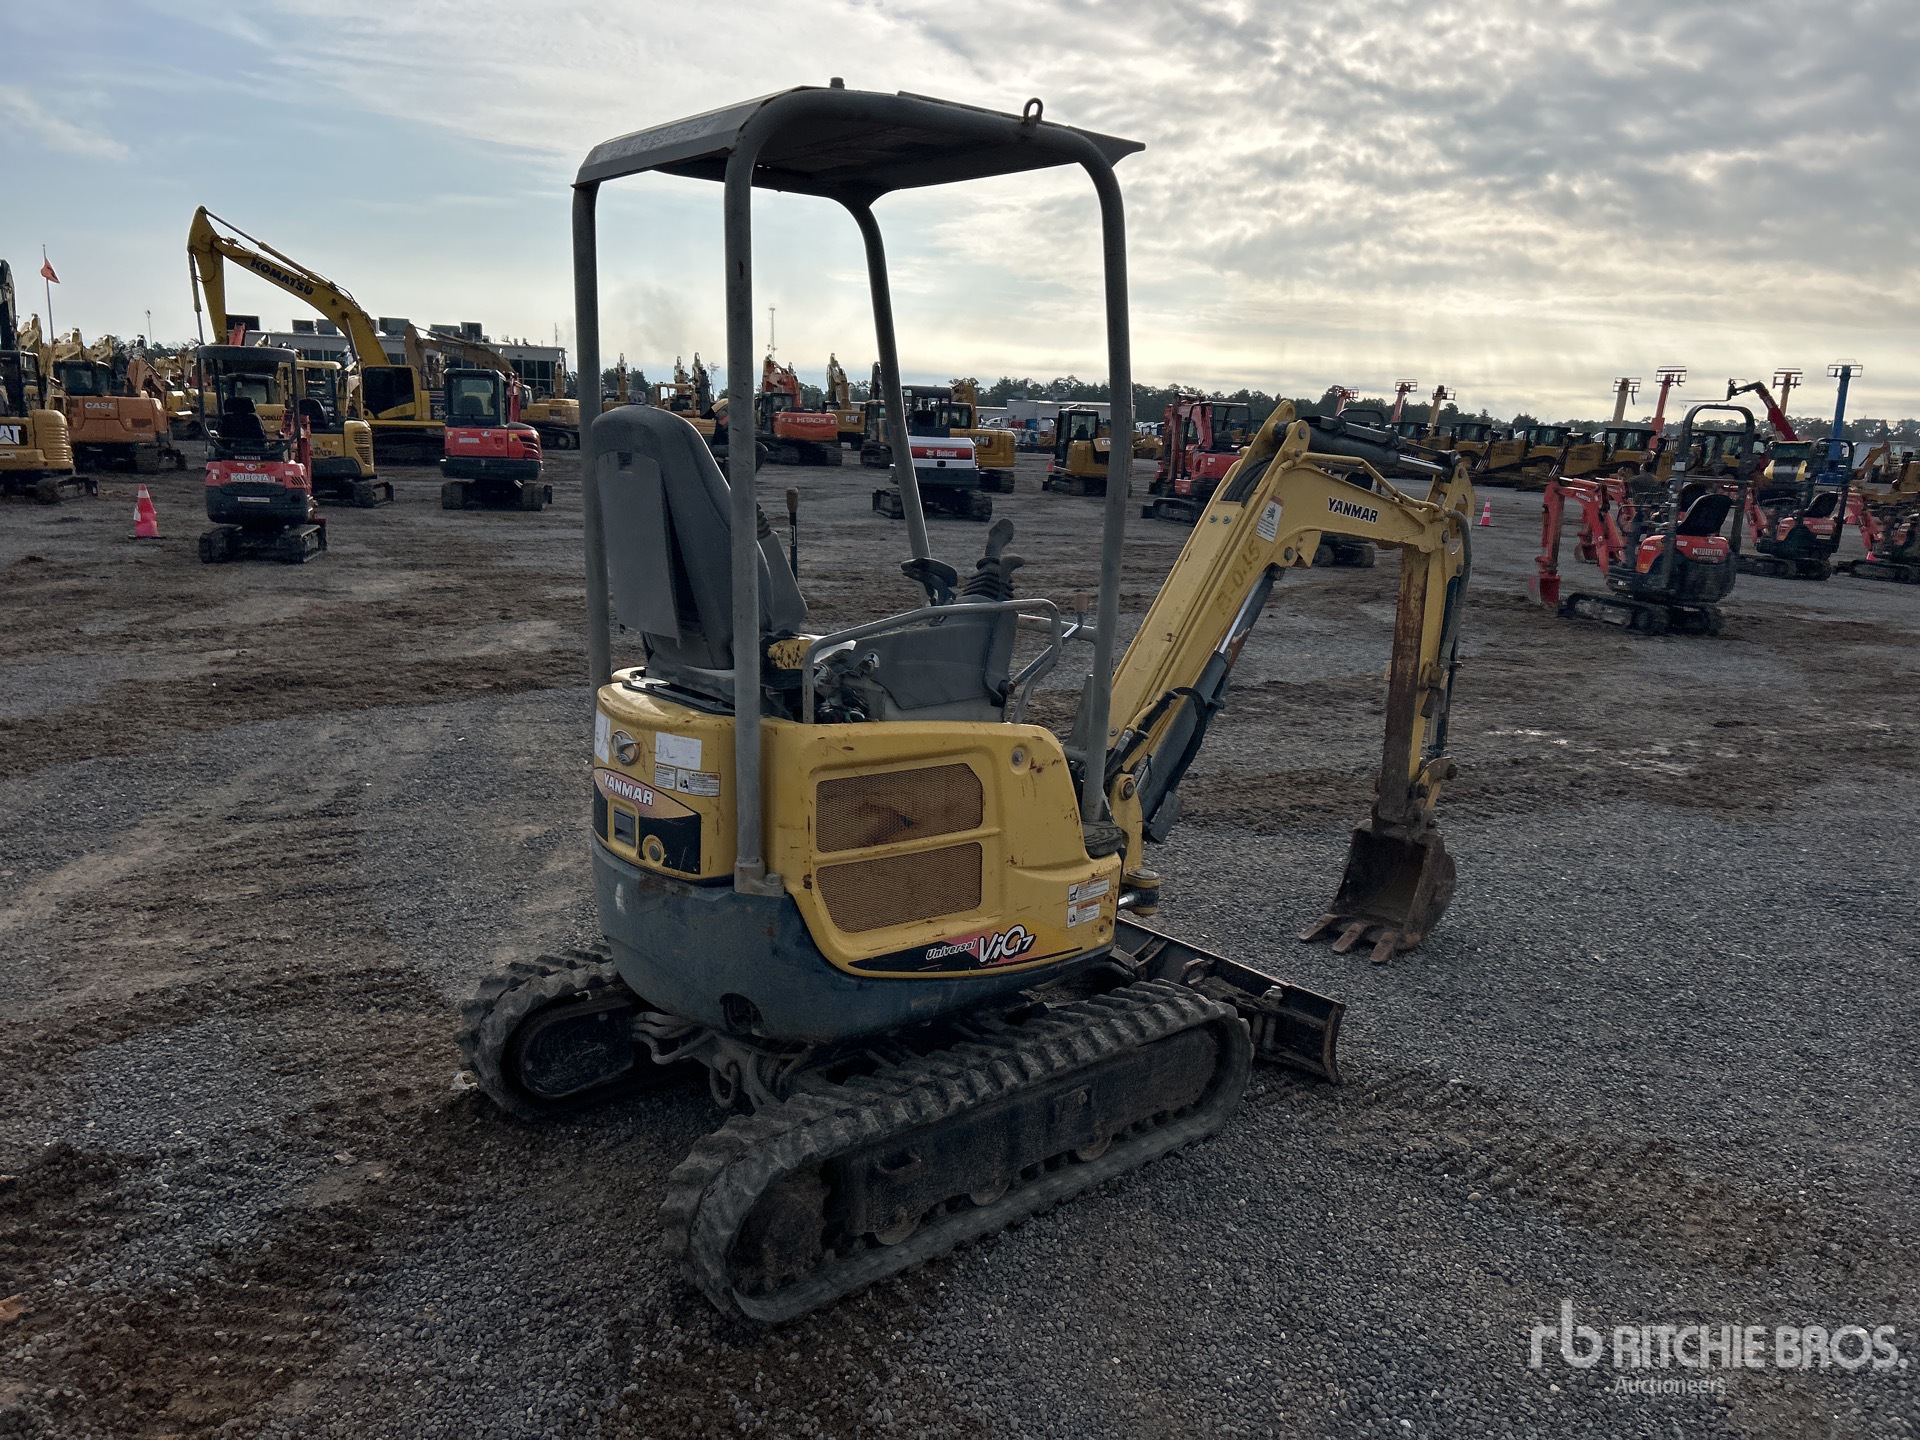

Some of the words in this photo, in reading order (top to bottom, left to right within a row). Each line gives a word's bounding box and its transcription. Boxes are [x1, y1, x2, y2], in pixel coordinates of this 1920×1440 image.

[250, 259, 315, 295] KOMATSU
[846, 415, 858, 423] CAT
[0, 425, 21, 445] AT
[937, 449, 957, 457] Bobcat
[231, 473, 269, 482] KUBOTA
[1328, 497, 1378, 523] YANMAR
[603, 773, 654, 806] YANMAR
[926, 938, 977, 960] Universal
